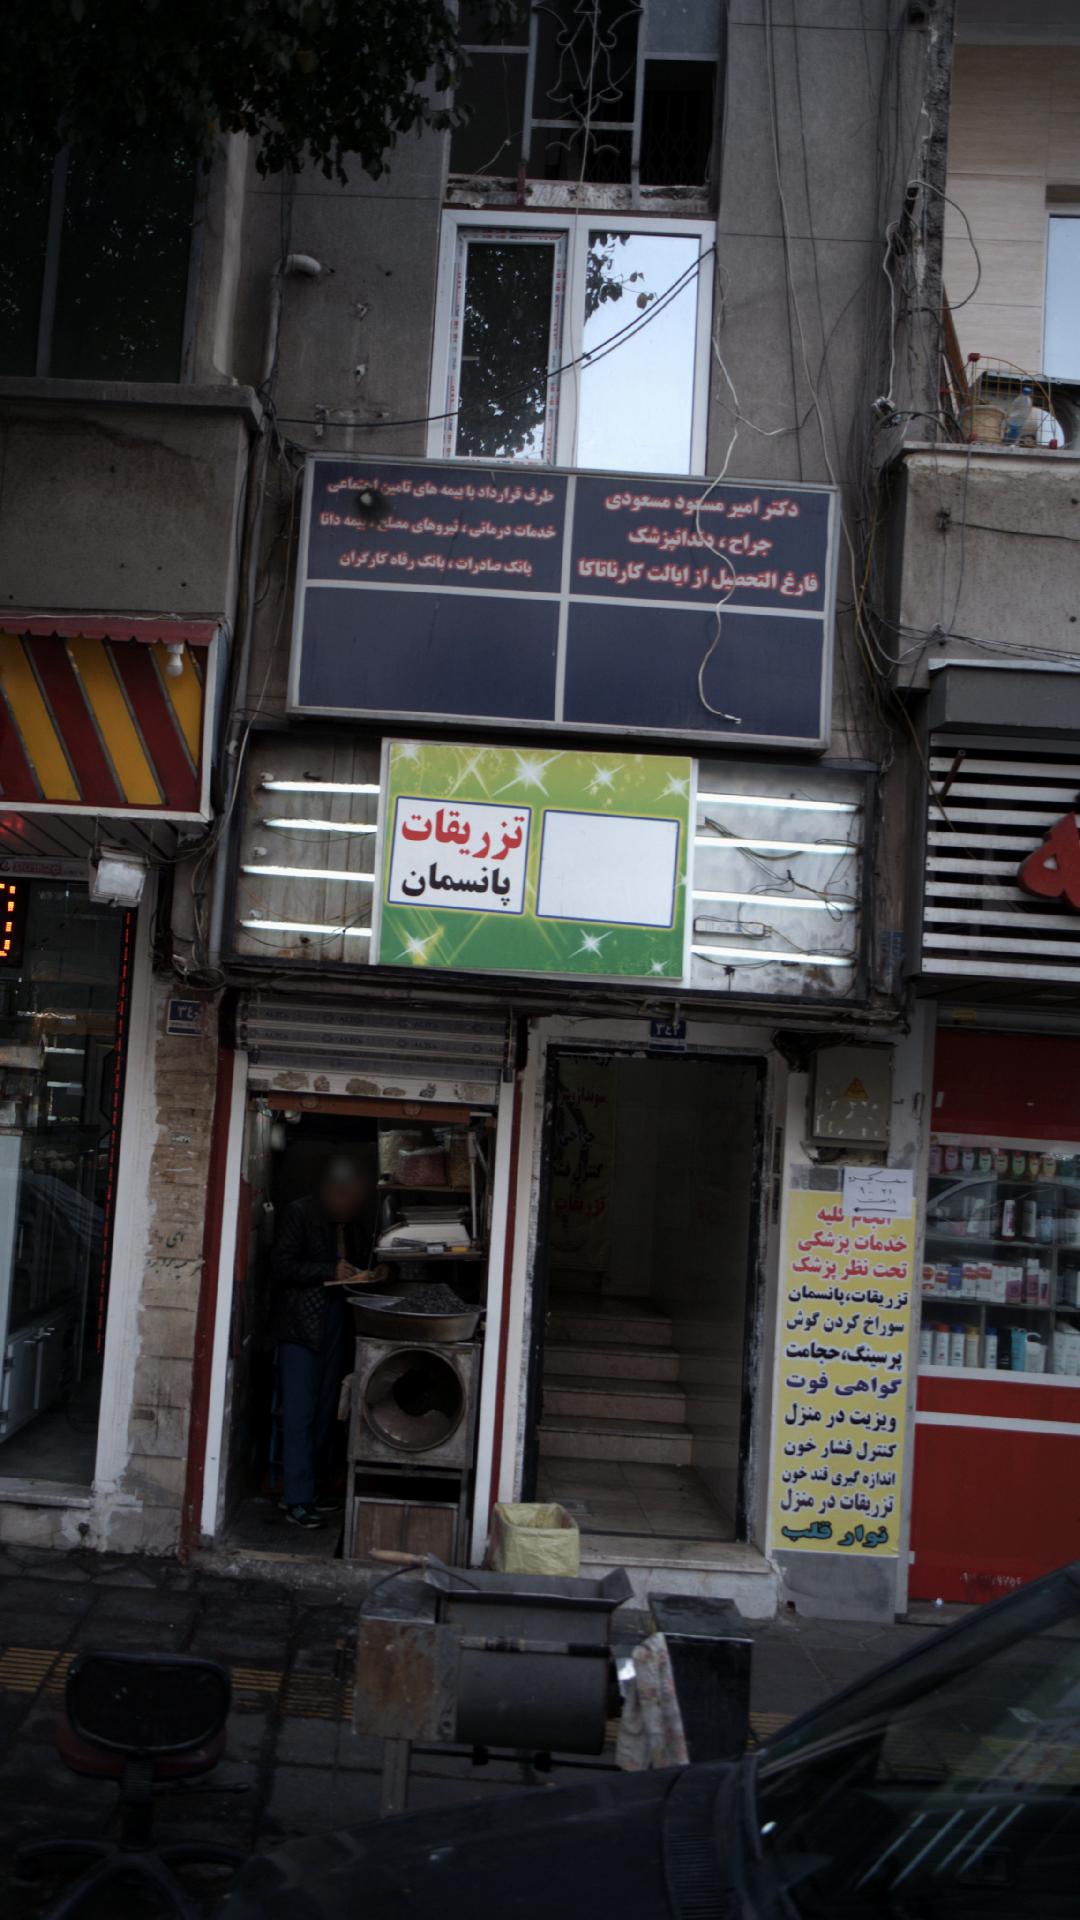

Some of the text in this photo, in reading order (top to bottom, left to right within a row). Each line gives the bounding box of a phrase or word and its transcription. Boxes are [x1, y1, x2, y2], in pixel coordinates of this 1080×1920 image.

[382, 479, 412, 495] تامین
[413, 481, 438, 498] های
[440, 485, 465, 501] بیمه
[466, 486, 476, 501] با
[478, 485, 521, 503] قرارداد
[524, 486, 555, 505] طرف
[605, 491, 799, 520] دکتر امیر مسعود مسعودی
[320, 512, 341, 526] دانا
[377, 513, 409, 531] مسلح
[411, 517, 459, 536] نیروهای
[469, 521, 512, 539] درمانی
[514, 522, 556, 539] خدمات
[628, 527, 715, 552] دندانپزشک
[728, 532, 773, 557] جراح
[390, 552, 415, 571] رفاه
[418, 554, 446, 572] بانک
[455, 557, 501, 575] صادرات
[504, 559, 533, 577] بانک
[577, 558, 819, 596] فارغ التحصیل از ایالت کارناتاکا
[402, 808, 525, 860] تزریقات
[402, 862, 510, 906] پانسمان
[798, 1231, 907, 1255] خدمات پزشکی
[793, 1257, 907, 1280] تحت نظر پزشک
[786, 1310, 904, 1336] سوراخ کردن گوش
[786, 1371, 902, 1399] گواهی فوت
[785, 1403, 896, 1432] ویزیت در منزل
[784, 1438, 897, 1462] کنترل فشار خون
[782, 1466, 896, 1489] اندازه گیری قند خون
[781, 1488, 894, 1518] تزریقات در منزل
[781, 1520, 889, 1548] نوار قلب
